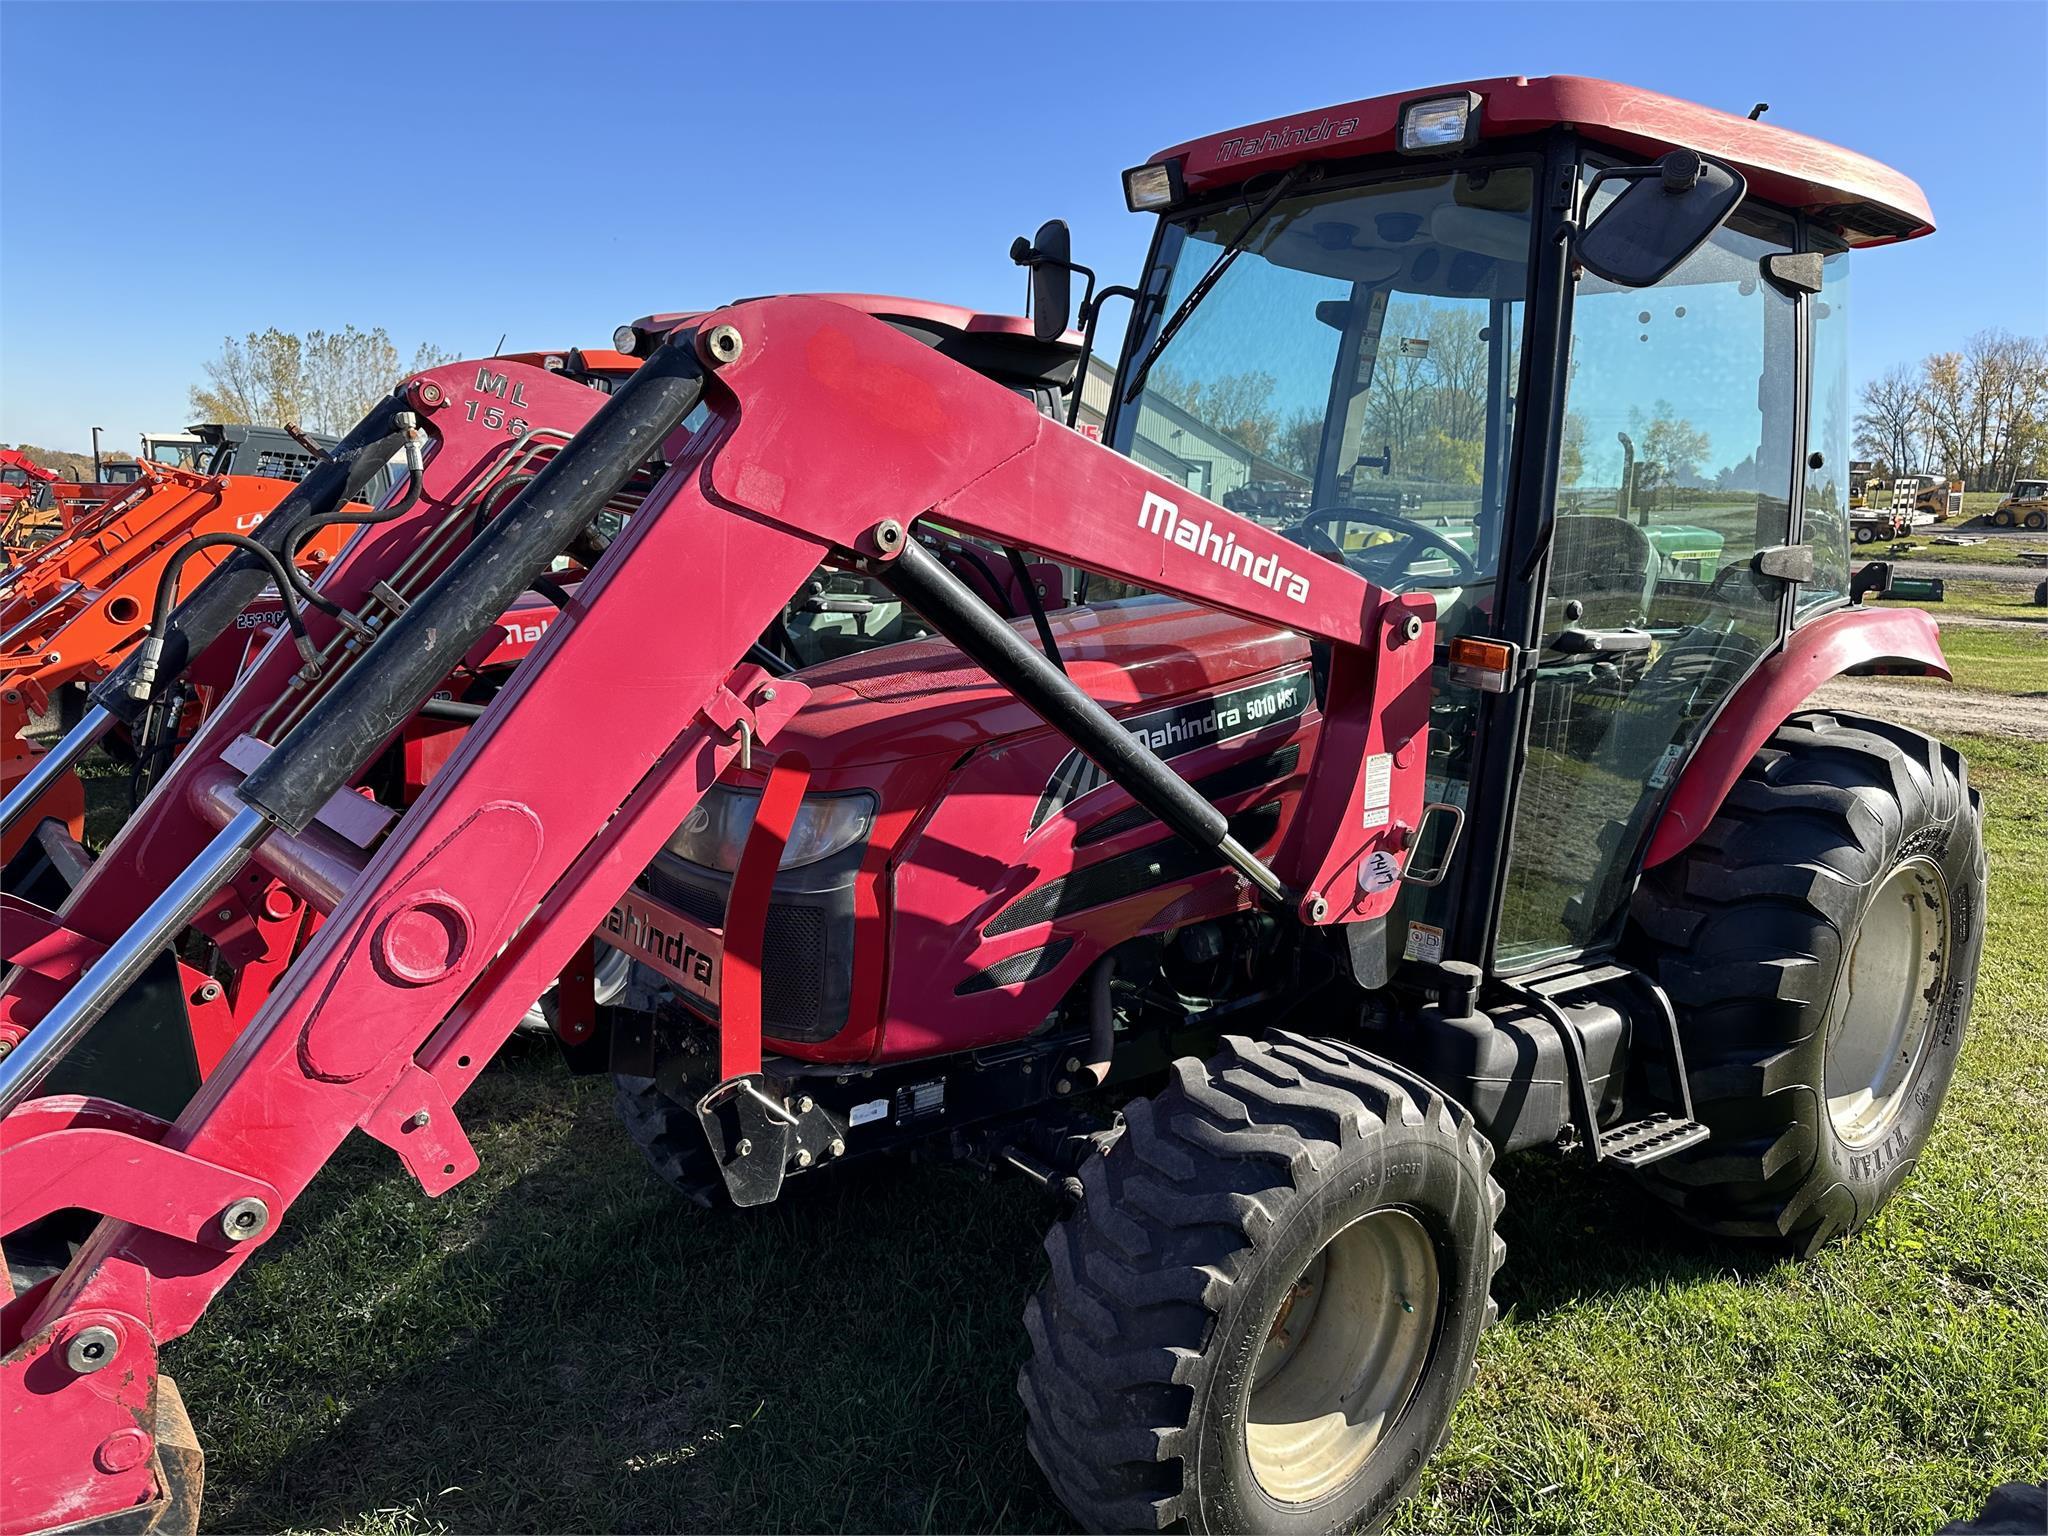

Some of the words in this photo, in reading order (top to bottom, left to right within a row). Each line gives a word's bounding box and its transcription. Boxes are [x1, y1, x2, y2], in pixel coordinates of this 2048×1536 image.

[1216, 117, 1359, 162] Mahindra
[475, 367, 528, 408] ML
[465, 400, 528, 438] 156
[1137, 490, 1310, 604] Mahindra
[1246, 695, 1275, 720] 5010
[1277, 687, 1298, 712] HST
[1371, 853, 1394, 884] 7417
[602, 905, 713, 987] ahindra
